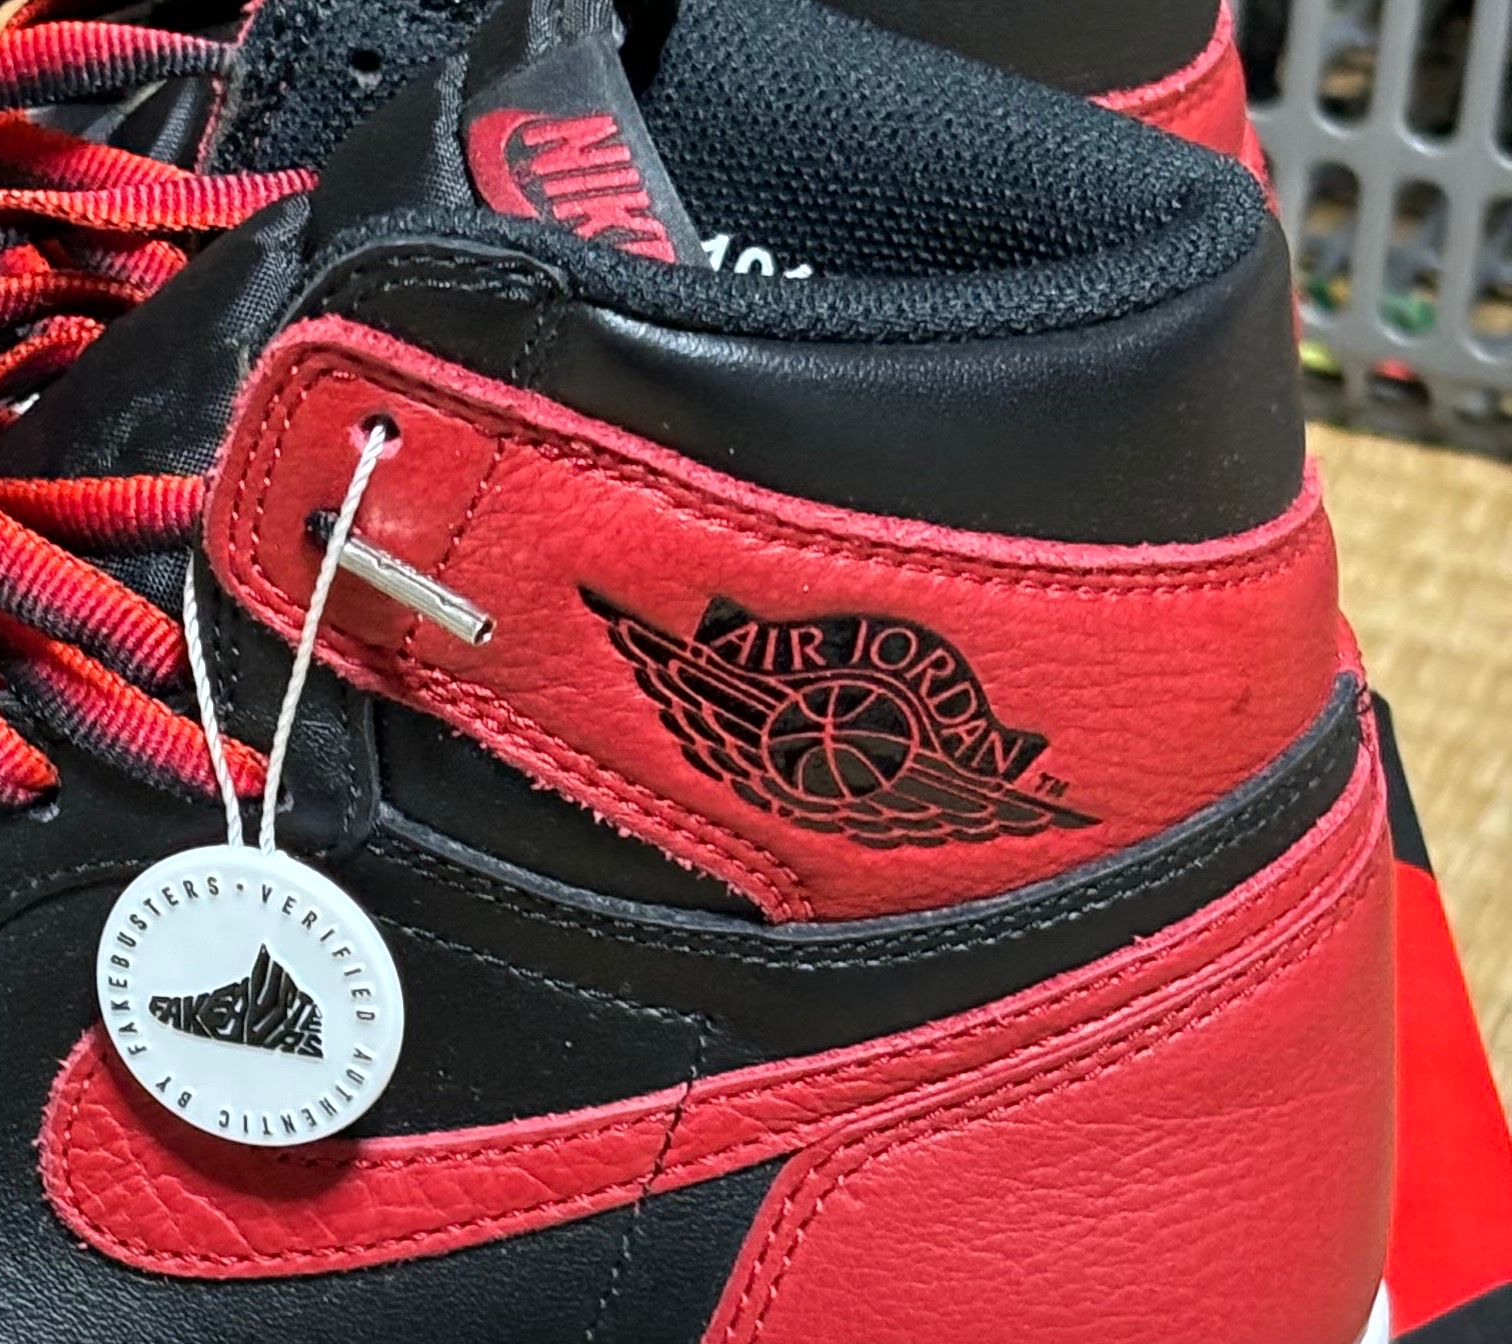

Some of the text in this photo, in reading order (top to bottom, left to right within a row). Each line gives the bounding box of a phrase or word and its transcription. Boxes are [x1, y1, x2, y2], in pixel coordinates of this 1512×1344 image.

[522, 113, 679, 266] NIK
[700, 233, 814, 280] 10
[710, 617, 1025, 777] AIR JORDAN
[106, 874, 377, 1138] VERIFIED AUTHENTIC BY FAKEBUSTERS
